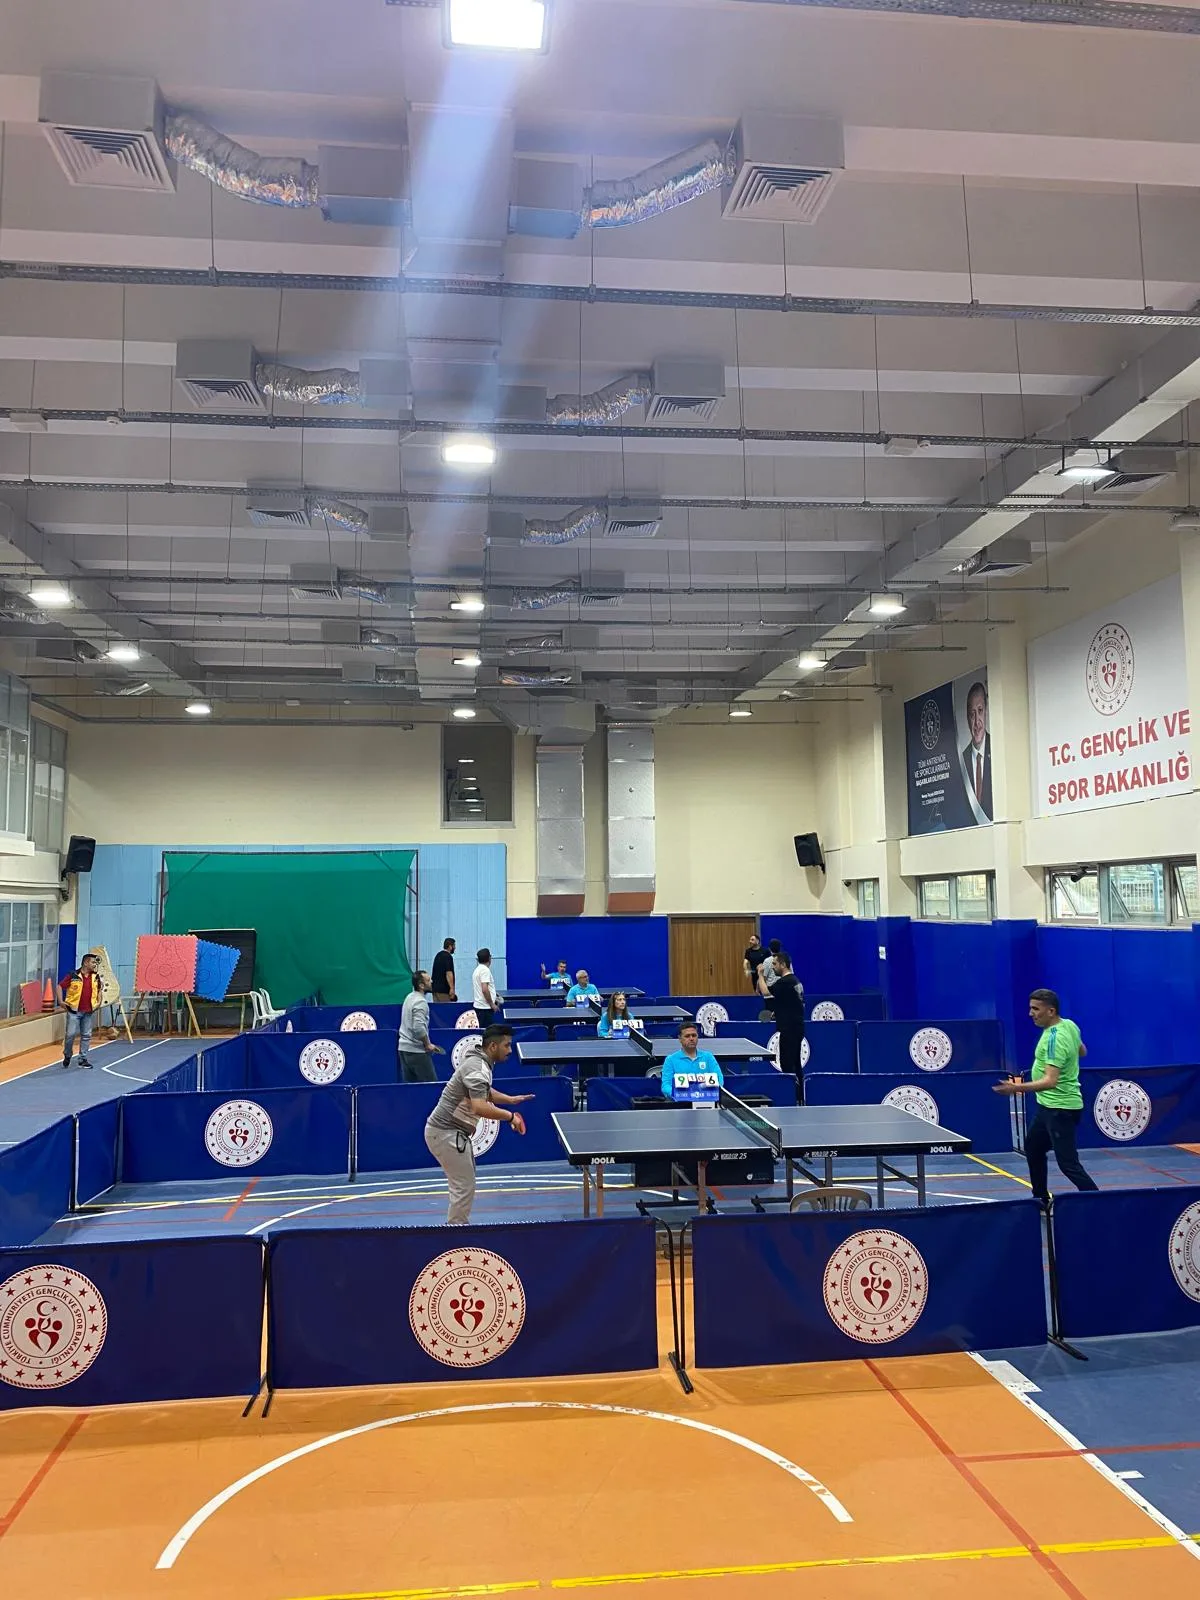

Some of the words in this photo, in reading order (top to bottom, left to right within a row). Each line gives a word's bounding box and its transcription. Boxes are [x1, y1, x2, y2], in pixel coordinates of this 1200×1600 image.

[1049, 743, 1076, 766] T.C.
[1081, 717, 1158, 759] GENÇLİK
[1164, 709, 1191, 738] VE
[1048, 777, 1090, 805] SPOR
[1094, 750, 1190, 797] BAKANLIĞ
[678, 1076, 685, 1086] 9
[708, 1075, 716, 1085] 6
[591, 1157, 615, 1165] JOOLA
[739, 1152, 748, 1160] 25
[929, 1146, 953, 1154] JOOLA
[868, 1249, 896, 1262] GENÇLİK
[895, 1259, 904, 1269] VE
[457, 1269, 487, 1281] GENÇLİK
[488, 1278, 499, 1288] VE
[843, 1252, 867, 1296] CUMHURİYETİ
[900, 1268, 909, 1288] SPOR
[36, 1287, 69, 1301] GENÇLİK
[68, 1298, 78, 1310] VE
[430, 1273, 456, 1320] CUMHURİYETİ
[495, 1287, 504, 1309] SPOR
[883, 1289, 909, 1320] BAKANLIĞI
[3, 1290, 35, 1340] CUMHURİYETİ
[73, 1308, 83, 1331] SPOR
[845, 1297, 867, 1320] TÜRKİYE
[433, 1321, 459, 1344] TÜRKİYE
[477, 1309, 504, 1343] BAKANLIĞI
[4, 1341, 31, 1365] TÜRKİYE
[51, 1331, 82, 1365] BAKANLIĞI
